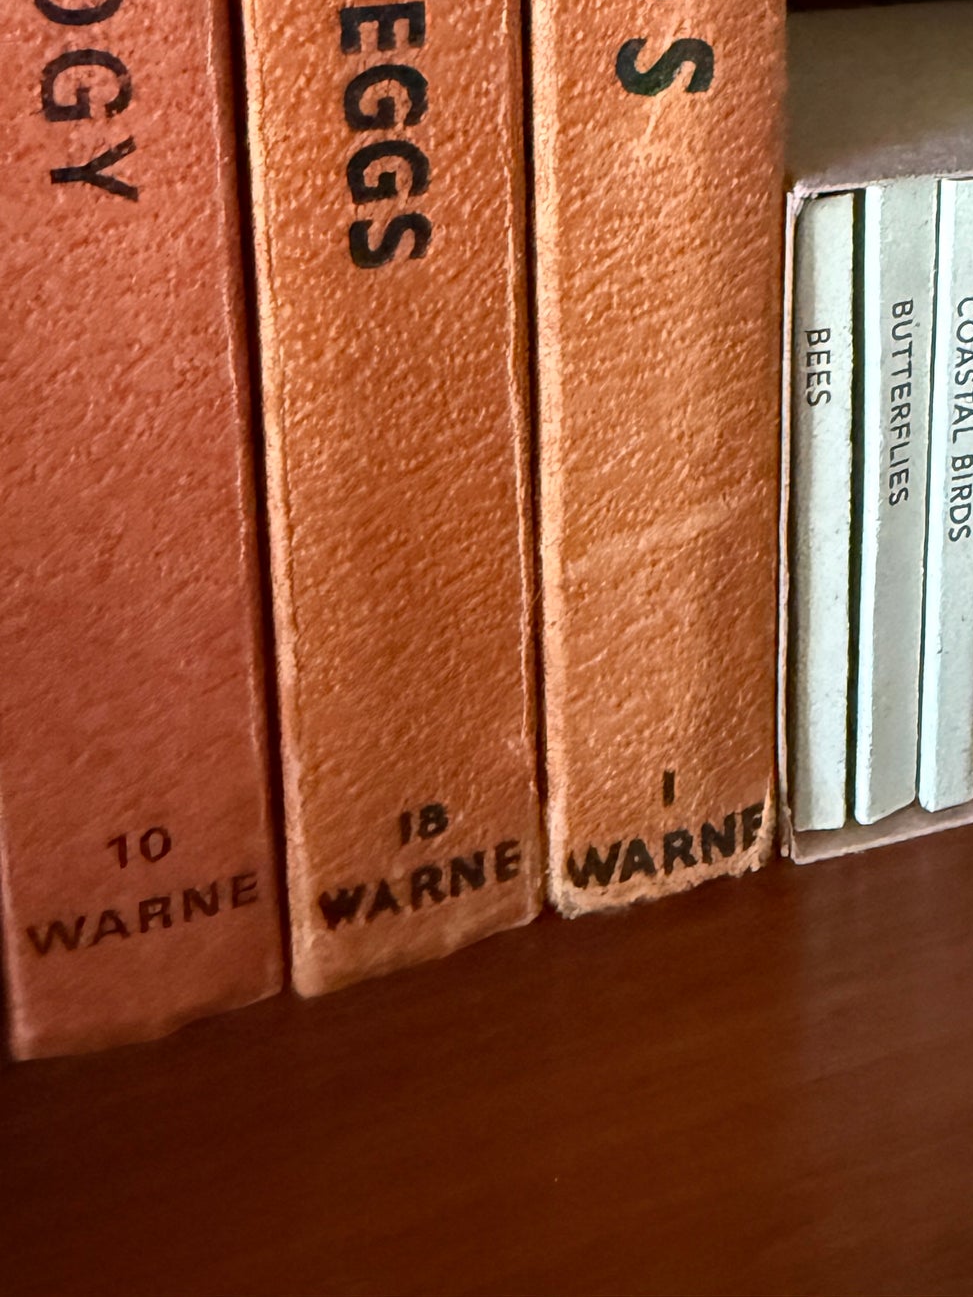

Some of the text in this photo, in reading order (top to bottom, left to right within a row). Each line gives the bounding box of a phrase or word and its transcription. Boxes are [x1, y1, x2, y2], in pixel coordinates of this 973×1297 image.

[339, 0, 432, 270] EGGS
[805, 327, 831, 408] BEES
[889, 299, 914, 506] BUTTERFLIES
[106, 825, 173, 870] 10
[398, 803, 450, 844] 18
[26, 870, 259, 958] WARNE
[316, 839, 522, 932] WARNE
